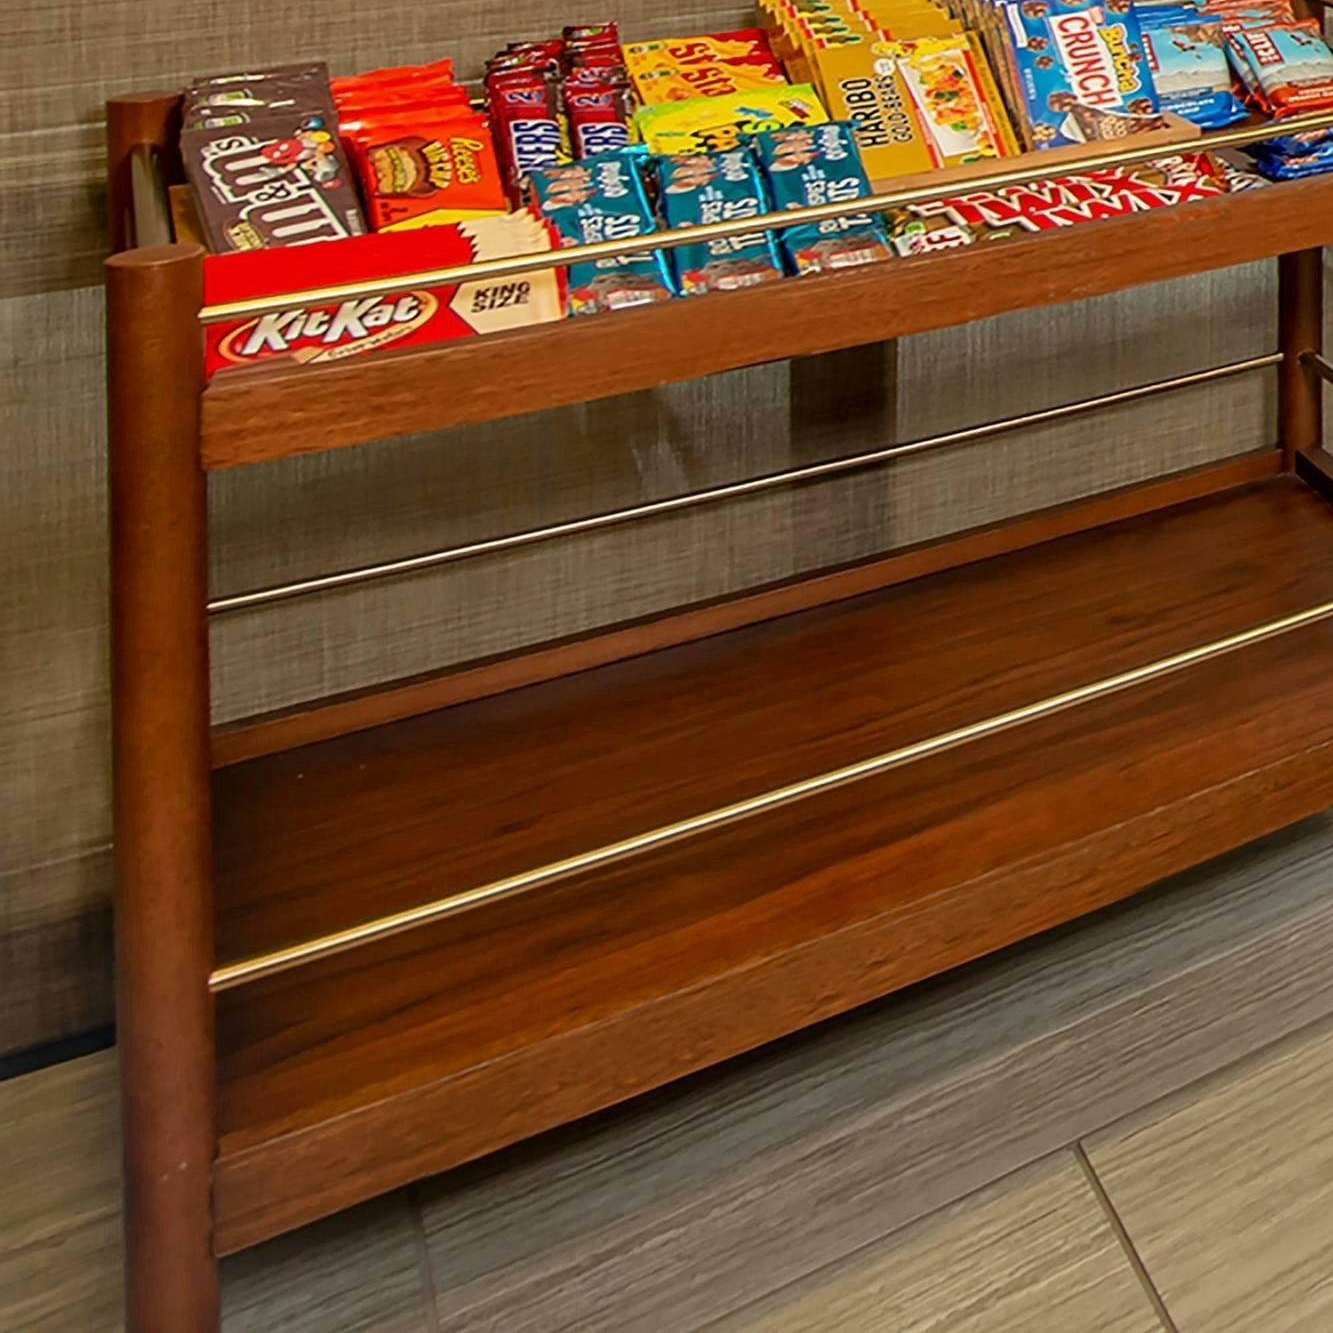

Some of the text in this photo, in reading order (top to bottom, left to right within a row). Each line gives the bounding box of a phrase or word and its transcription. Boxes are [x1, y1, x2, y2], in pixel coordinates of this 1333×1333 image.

[1058, 16, 1121, 107] CRUNCH
[1099, 26, 1138, 92] Buncha
[841, 78, 890, 148] HARIBO
[472, 295, 530, 313] SIZE
[474, 281, 531, 300] KING
[240, 293, 422, 356] KitKat
